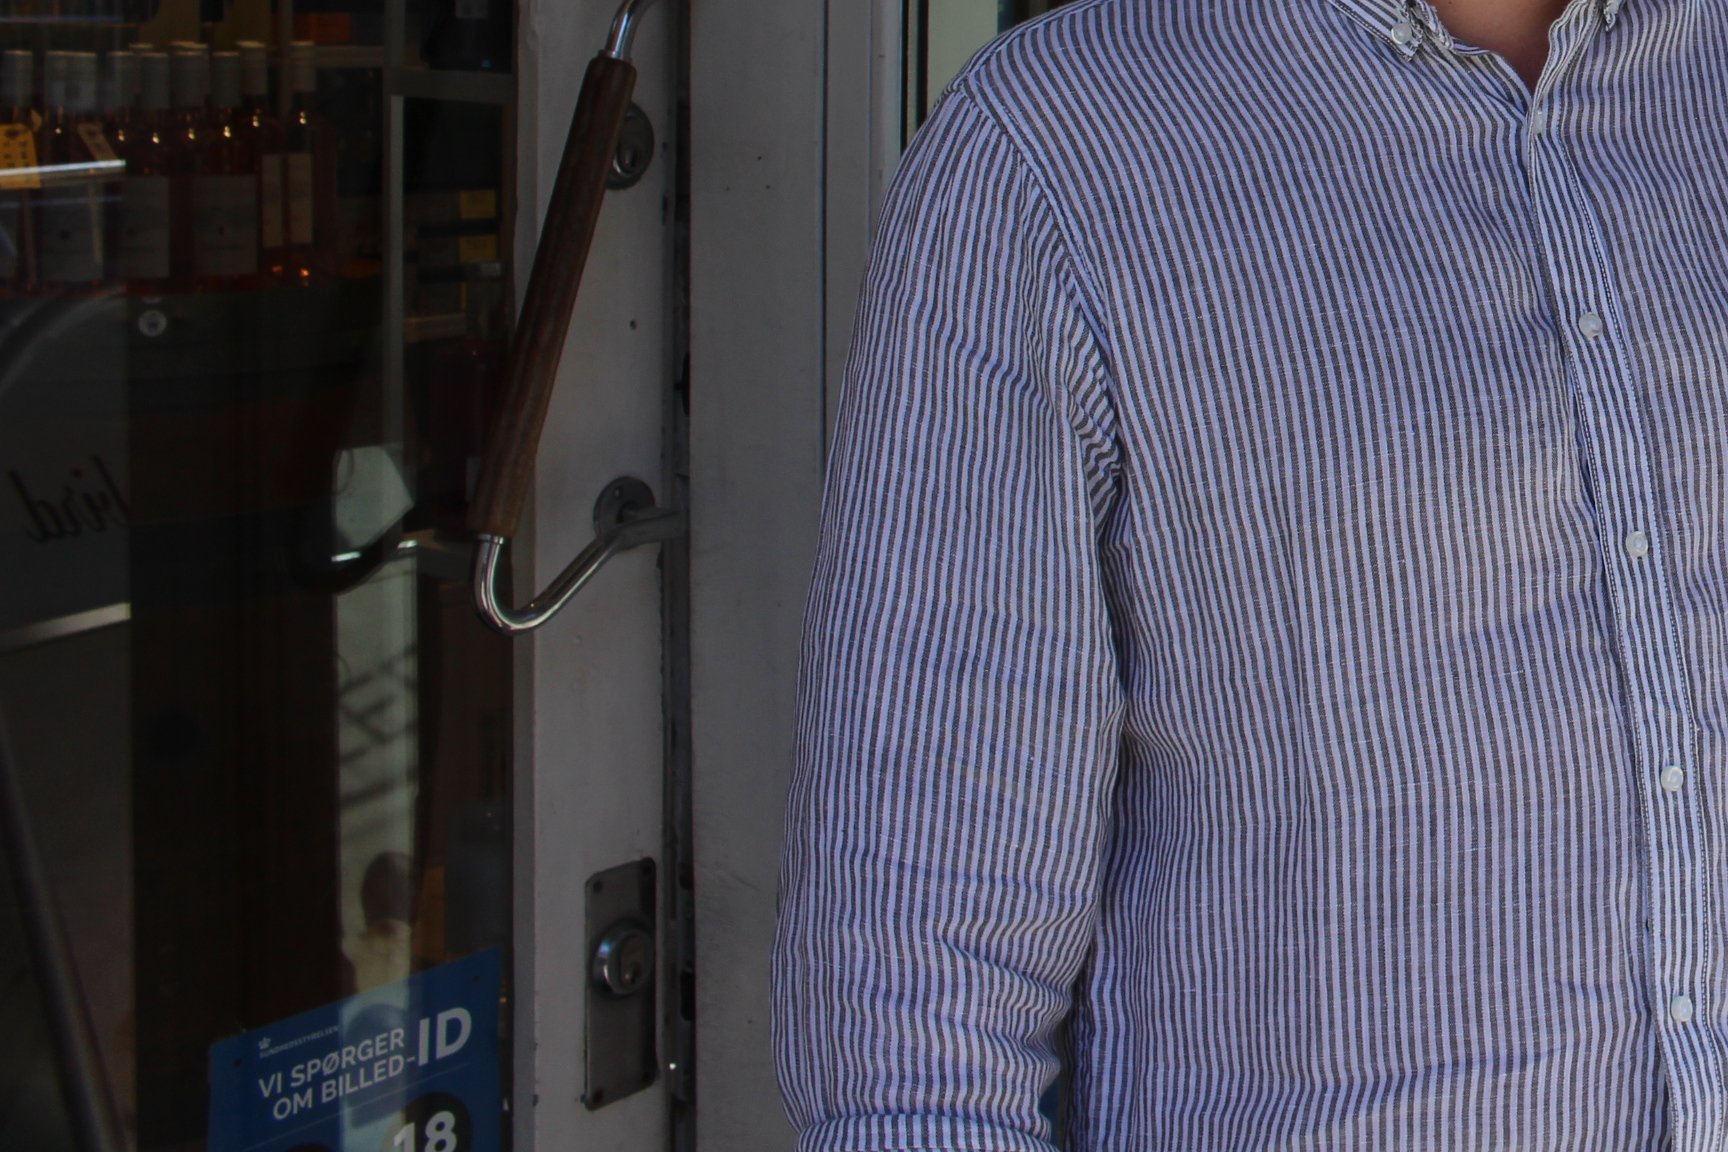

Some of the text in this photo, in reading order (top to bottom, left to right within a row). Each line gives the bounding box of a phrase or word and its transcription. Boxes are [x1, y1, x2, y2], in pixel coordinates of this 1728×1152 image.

[258, 1028, 405, 1098] VI SPØRGER
[273, 1092, 313, 1120] OM
